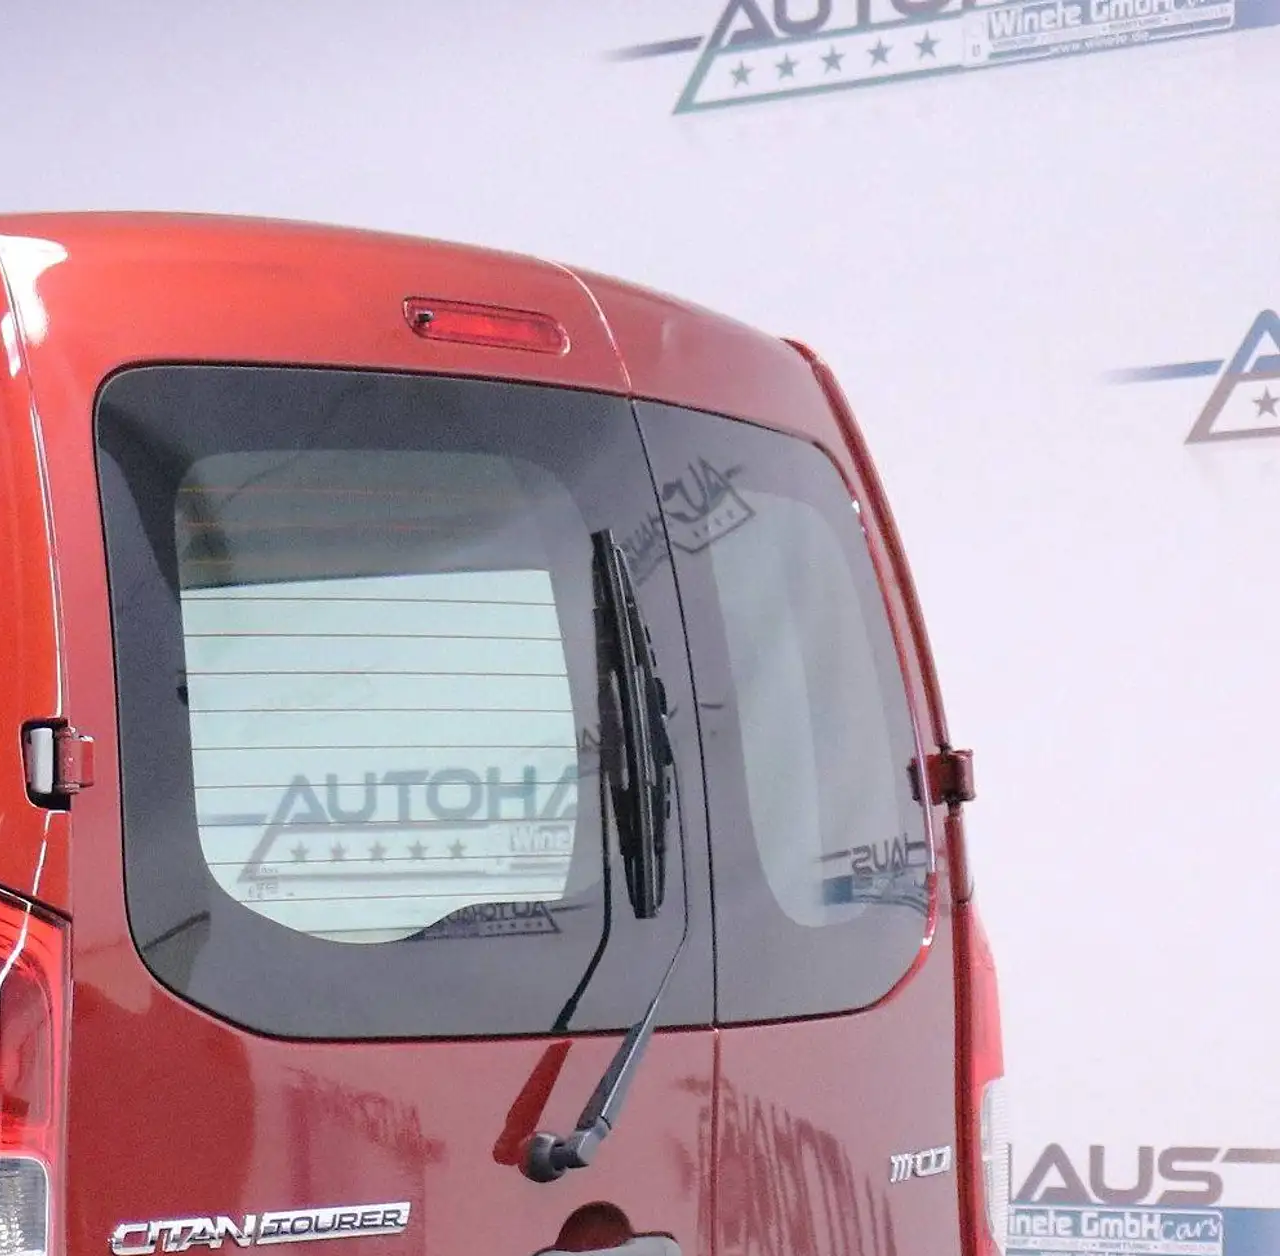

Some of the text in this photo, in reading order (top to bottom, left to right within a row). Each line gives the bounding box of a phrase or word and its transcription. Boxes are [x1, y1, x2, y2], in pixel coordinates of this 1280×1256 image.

[1007, 1142, 1224, 1206] AUS
[111, 1206, 409, 1256] CITAN TOURER
[1080, 1211, 1161, 1240] GmbH
